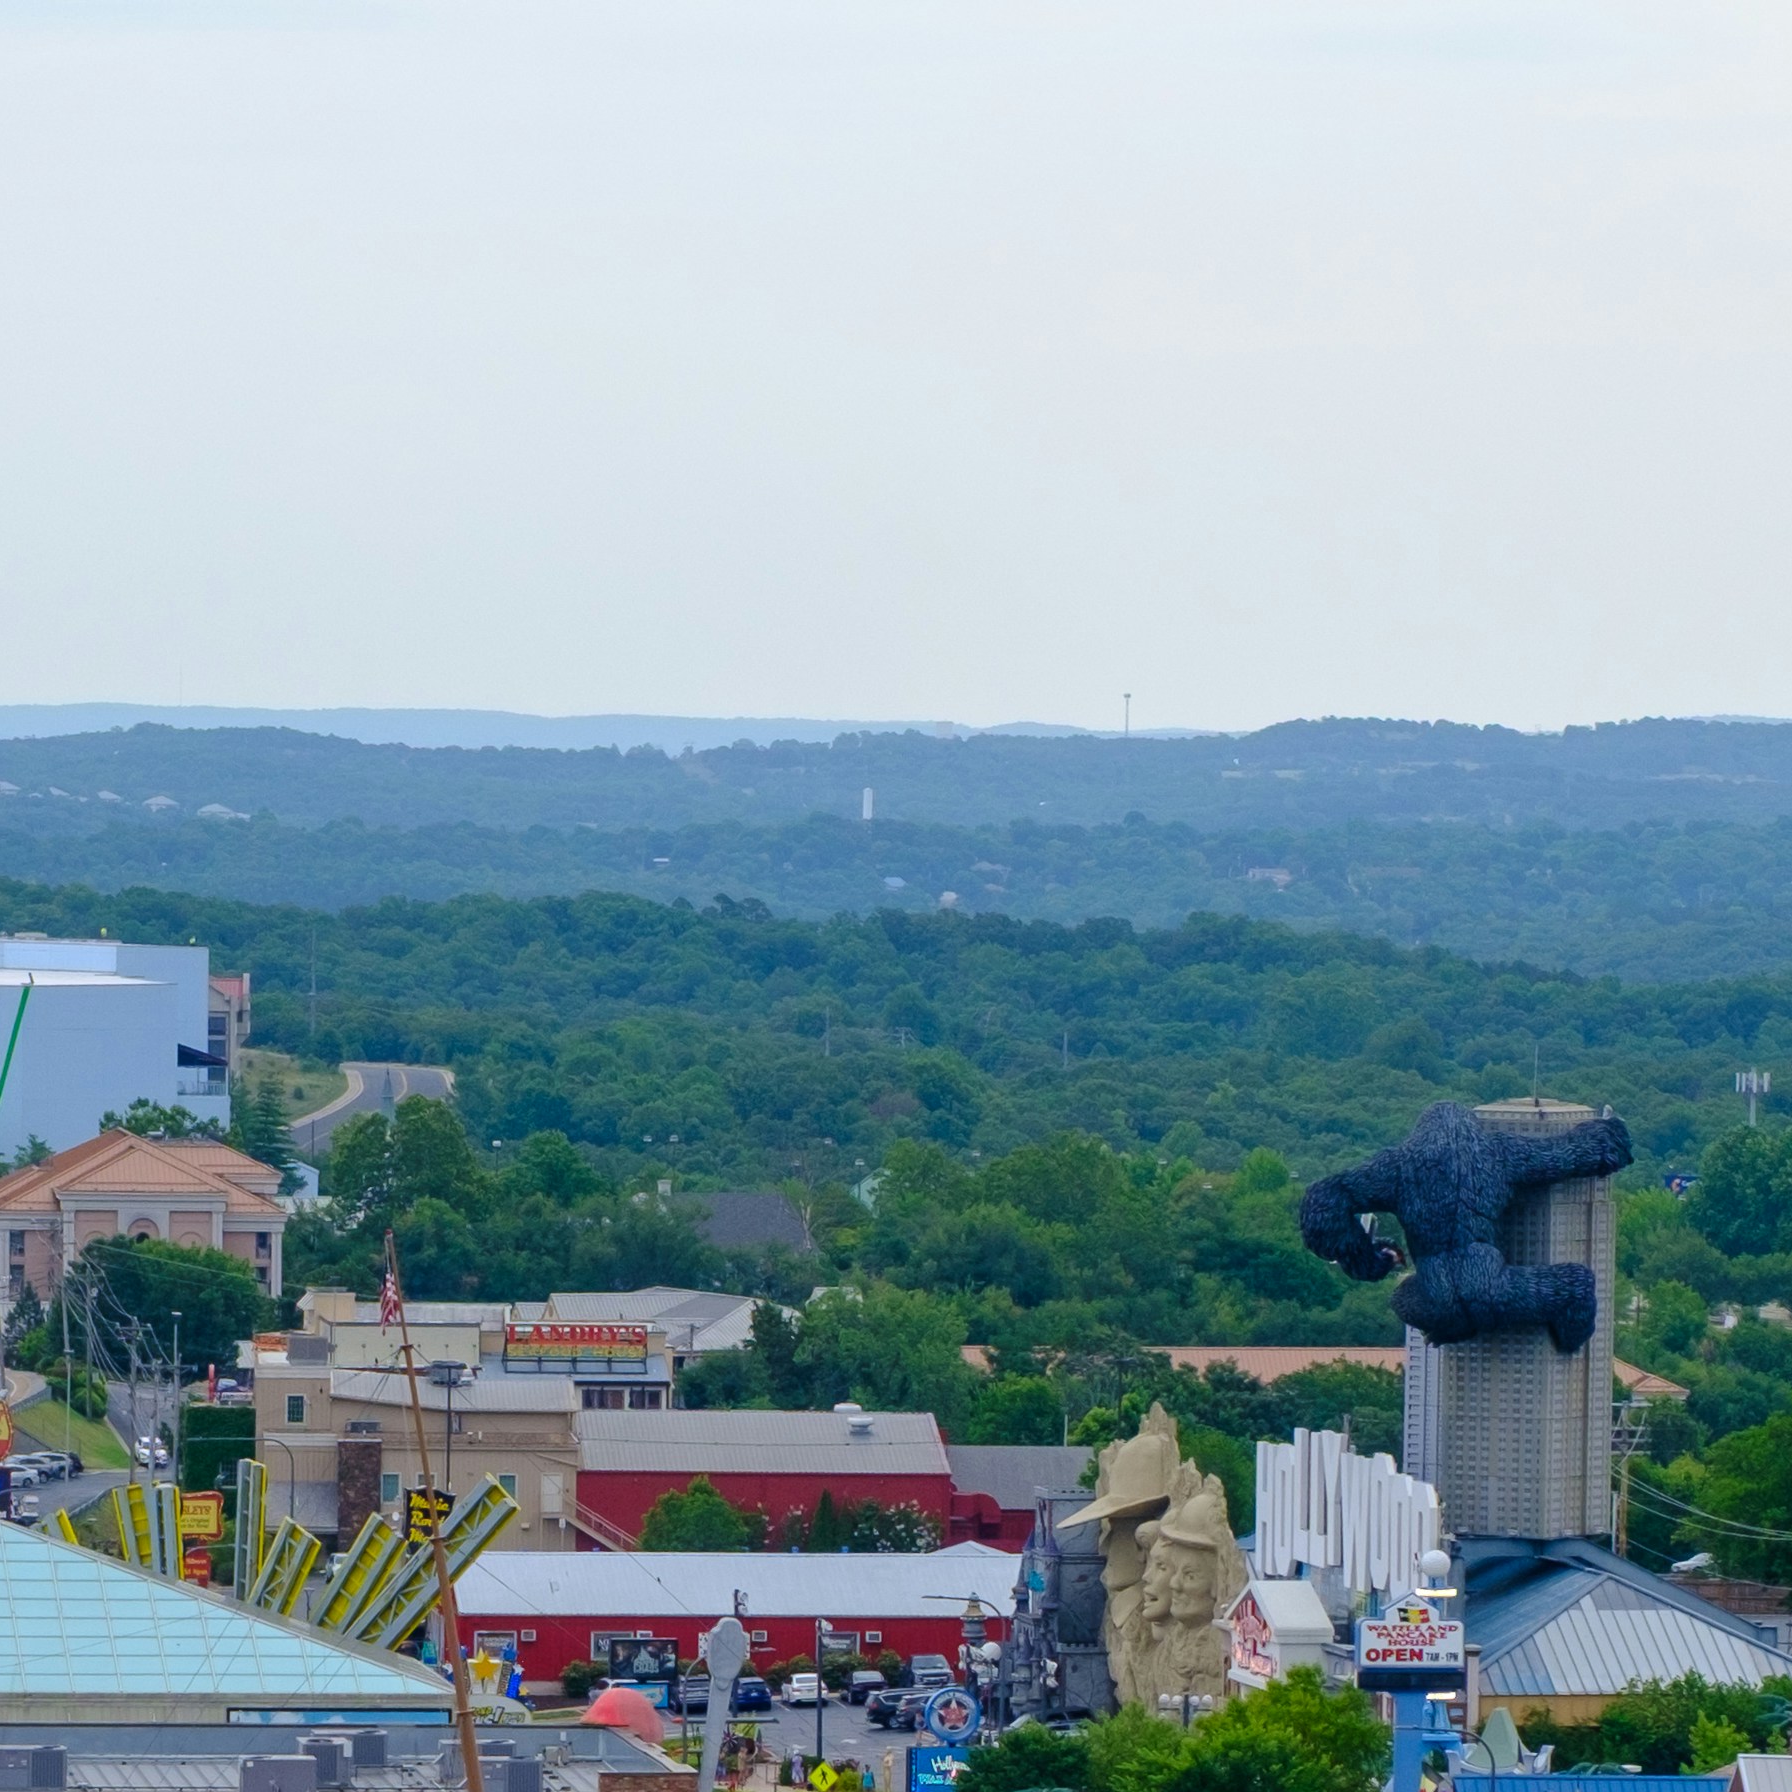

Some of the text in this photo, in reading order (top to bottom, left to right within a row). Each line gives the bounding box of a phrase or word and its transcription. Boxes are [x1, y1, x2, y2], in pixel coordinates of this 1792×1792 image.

[506, 1324, 647, 1345] LANDRY'S
[1366, 1624, 1459, 1632] WAFFLE AND
[1365, 1648, 1424, 1662] OPEN
